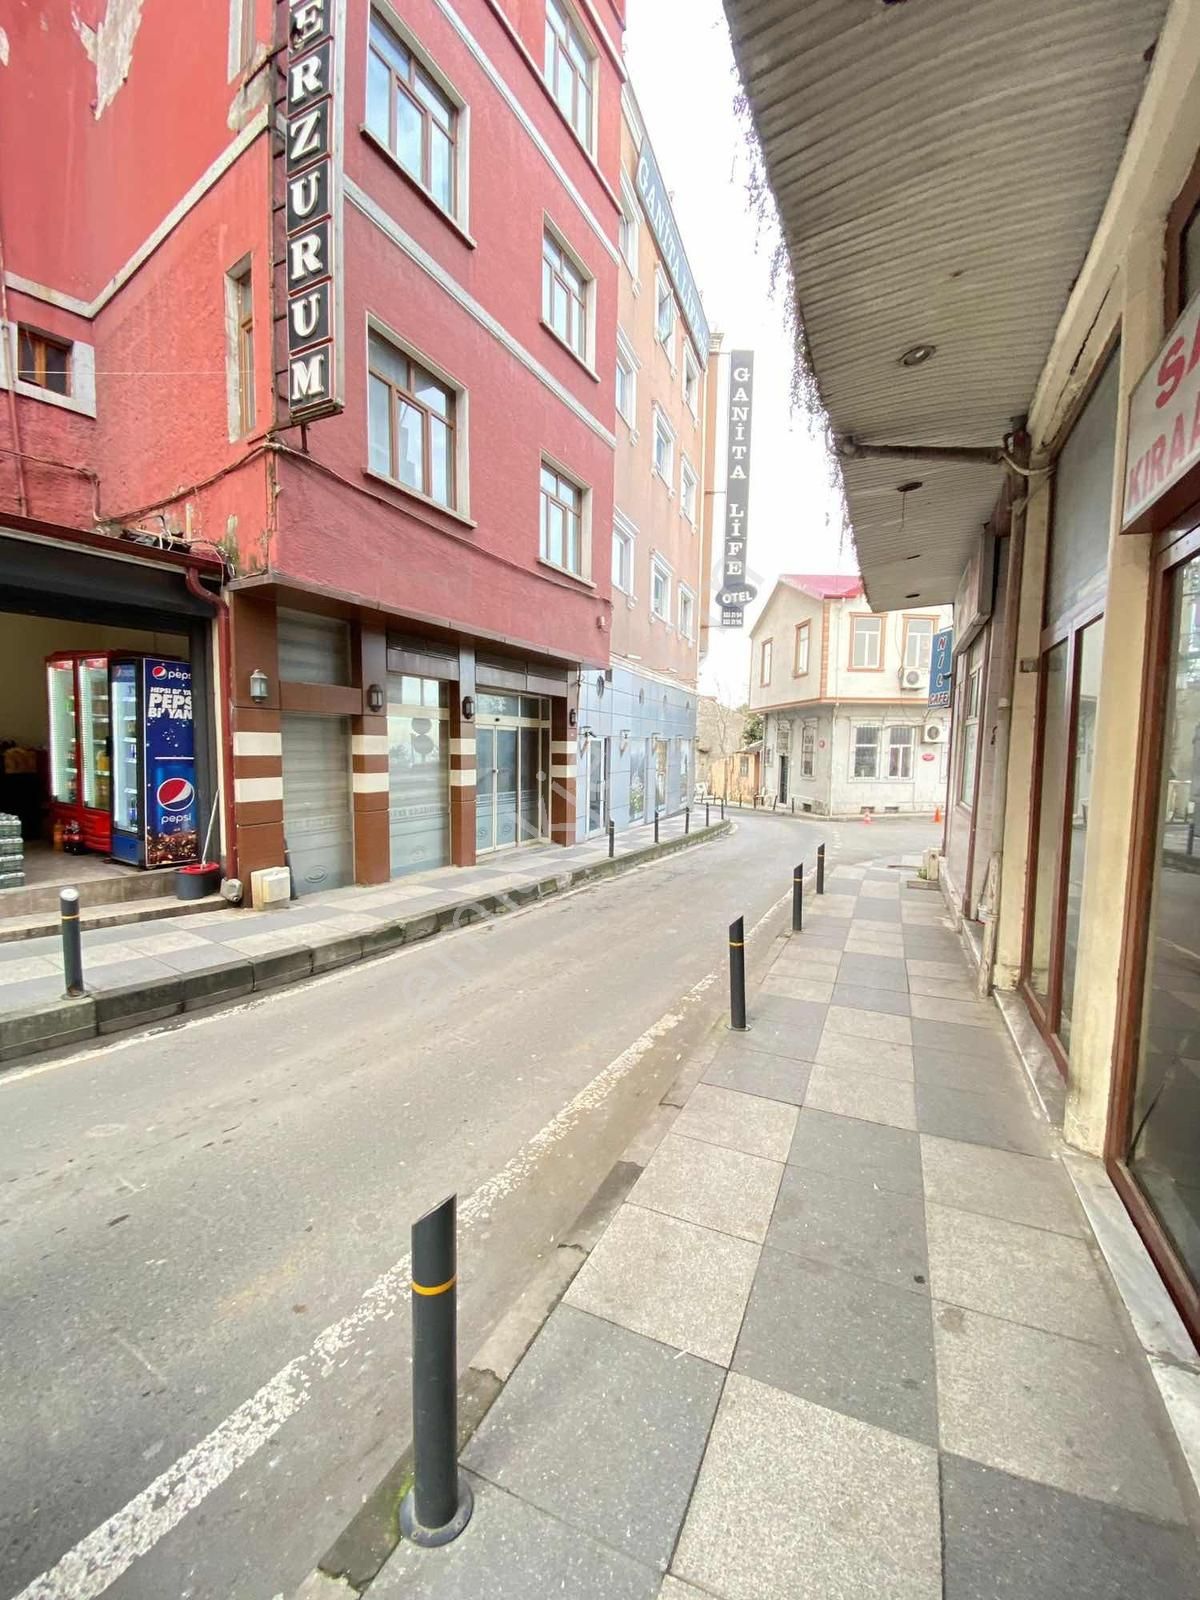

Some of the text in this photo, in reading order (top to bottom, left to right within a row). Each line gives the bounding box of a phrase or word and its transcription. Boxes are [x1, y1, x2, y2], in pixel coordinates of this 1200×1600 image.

[289, 0, 325, 402] ERZURUM
[727, 366, 751, 576] GANİTA LİFE
[721, 591, 753, 604] OTEL
[161, 812, 192, 825] pepsi
